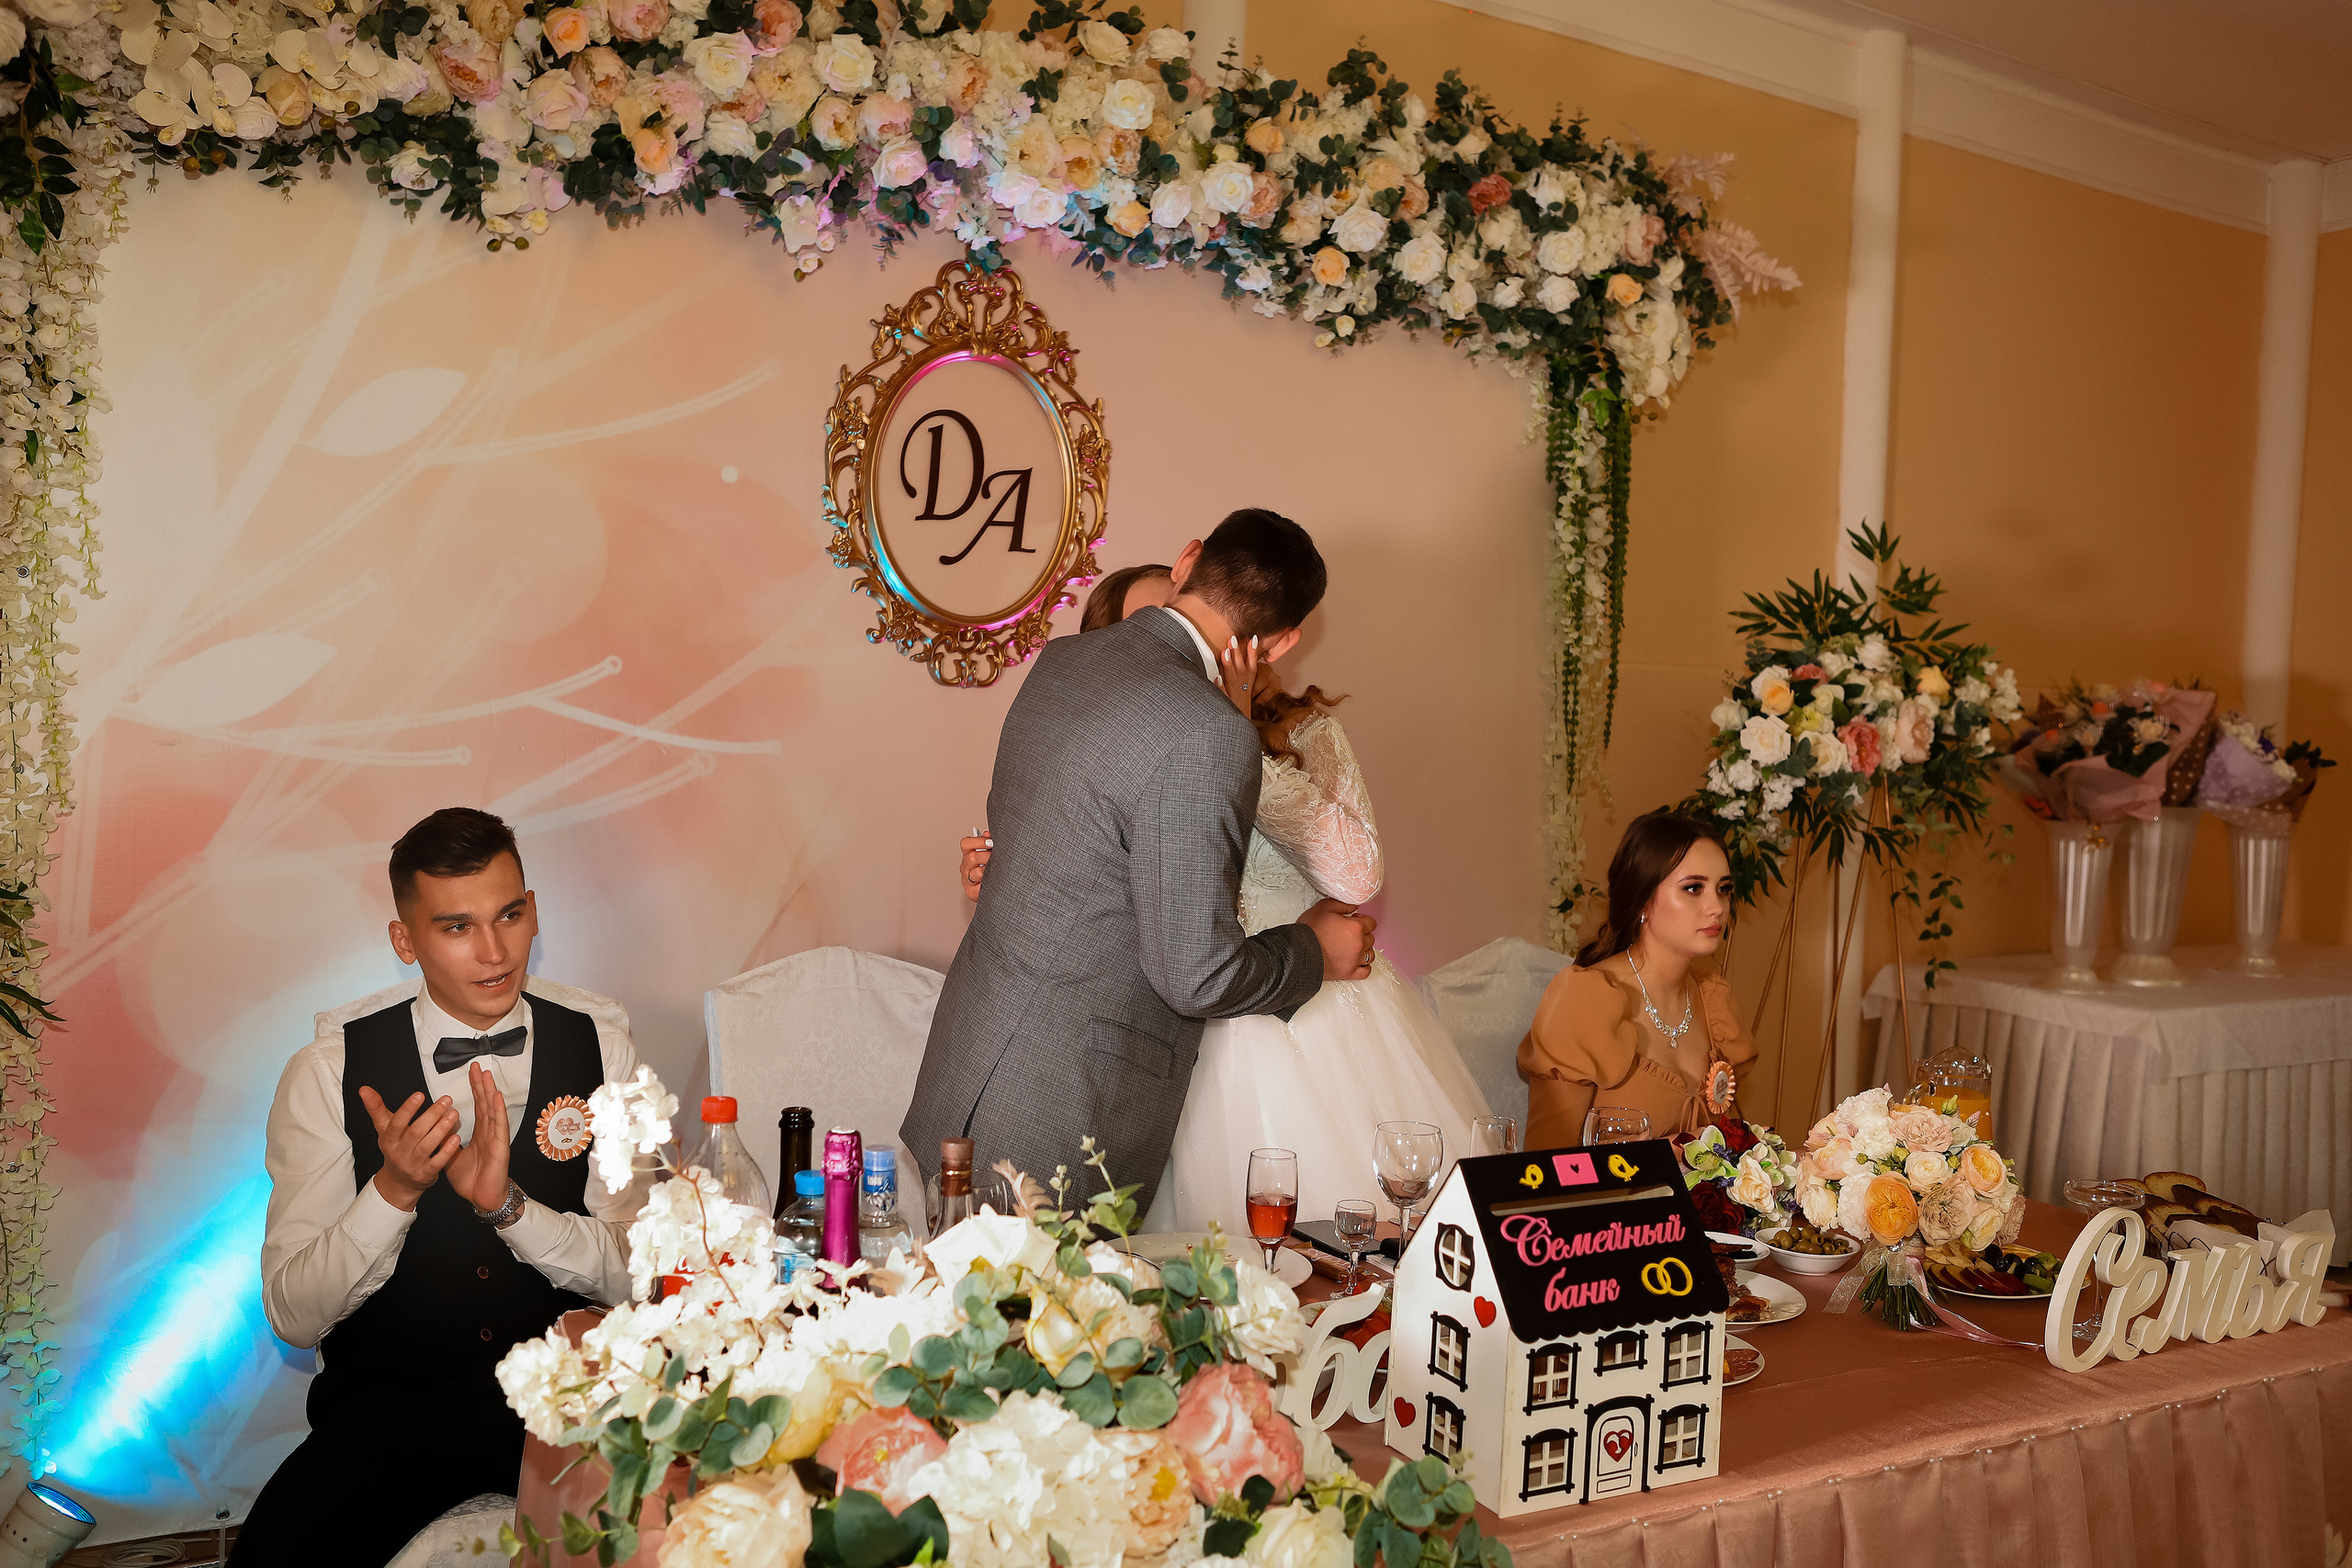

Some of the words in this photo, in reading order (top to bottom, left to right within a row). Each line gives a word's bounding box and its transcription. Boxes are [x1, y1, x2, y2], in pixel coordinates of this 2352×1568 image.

[1499, 1213, 1686, 1267] Семейный
[1544, 1266, 1621, 1313] банк
[2044, 1206, 2336, 1373] Семья
